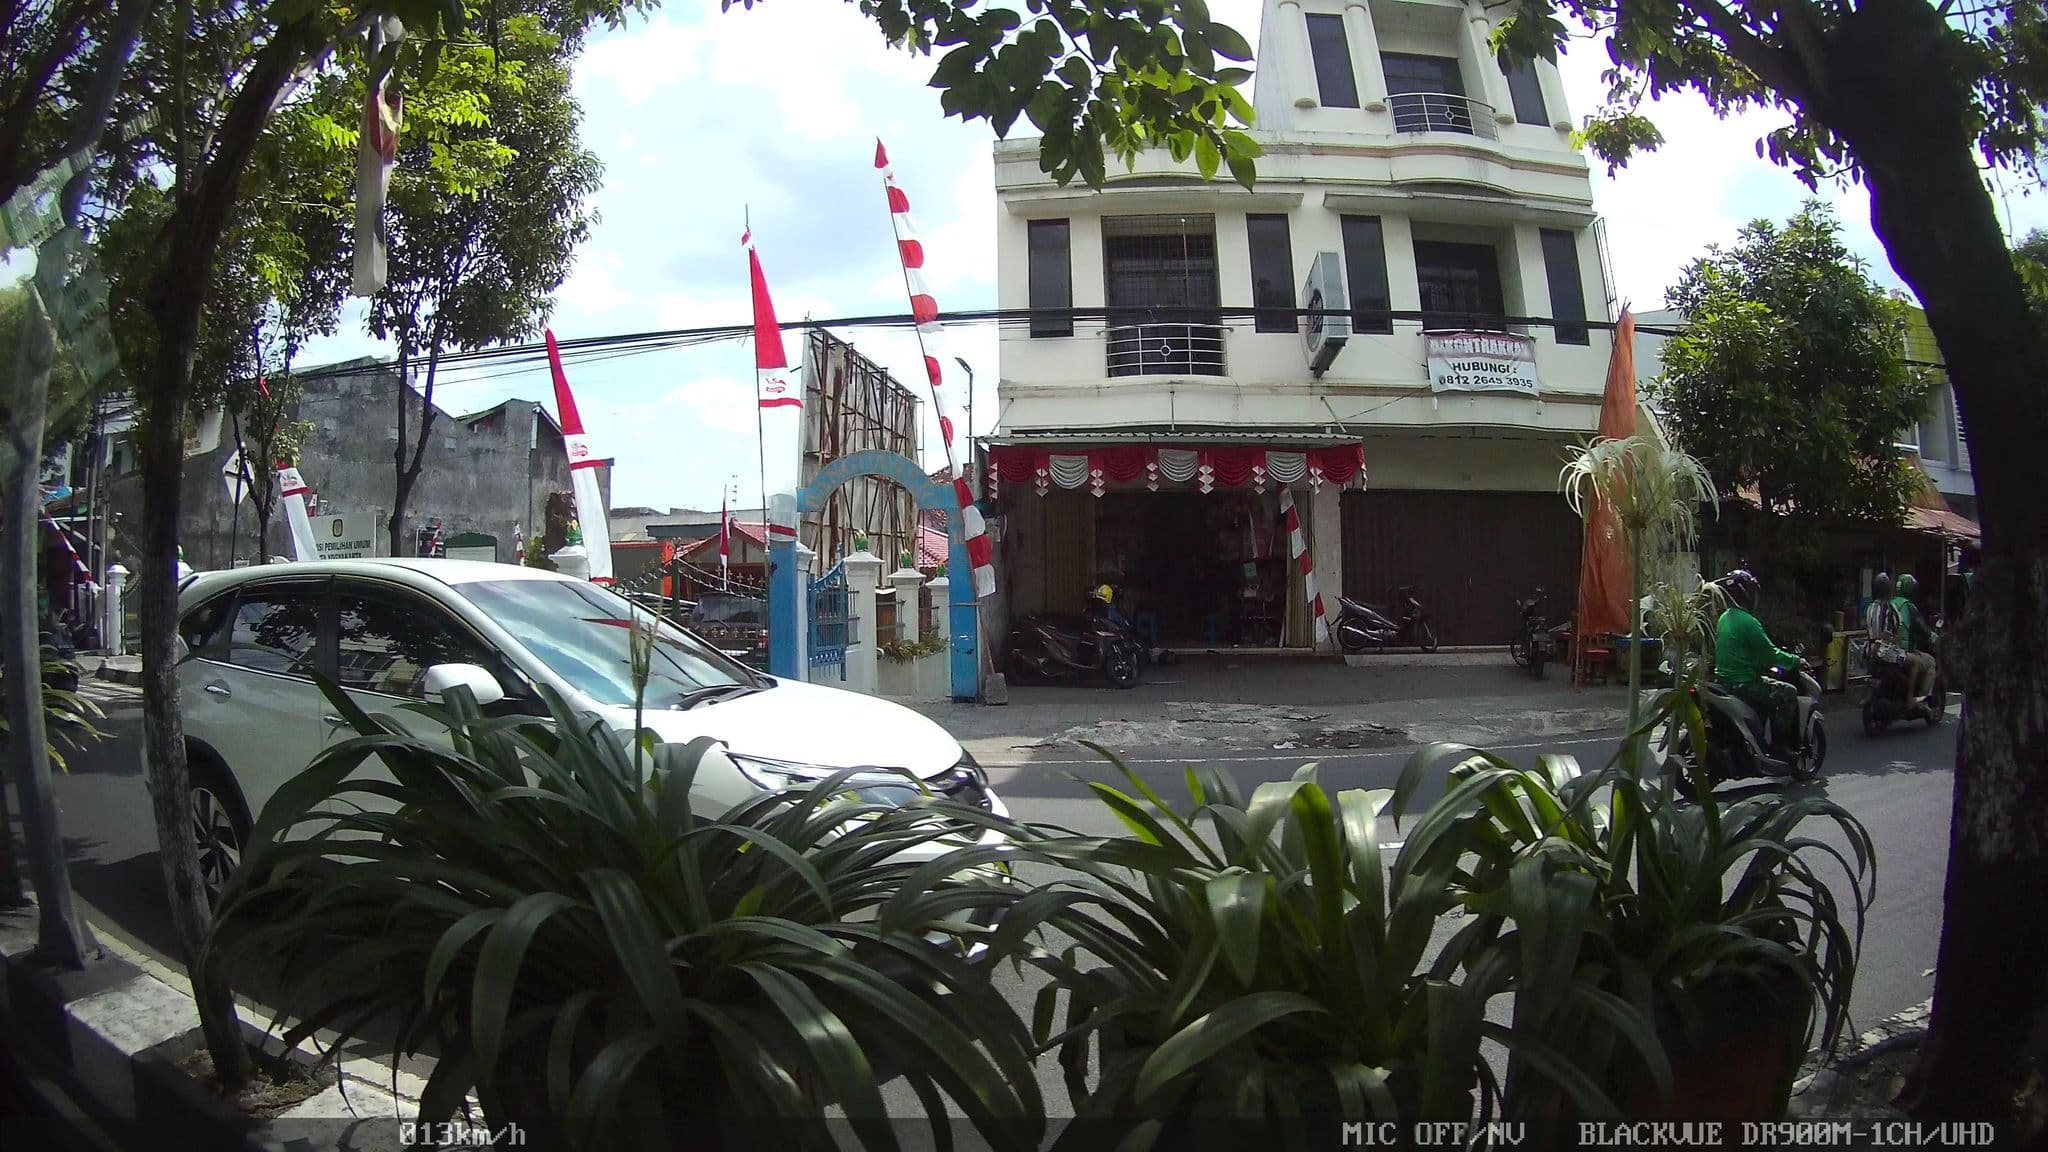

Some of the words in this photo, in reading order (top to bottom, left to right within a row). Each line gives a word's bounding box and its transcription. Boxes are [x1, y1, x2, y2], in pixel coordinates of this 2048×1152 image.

[1453, 361, 1510, 374] HUBUNGI
[1438, 375, 1470, 385] 0812
[1473, 375, 1503, 385] 2645
[1506, 377, 1534, 388] 3935
